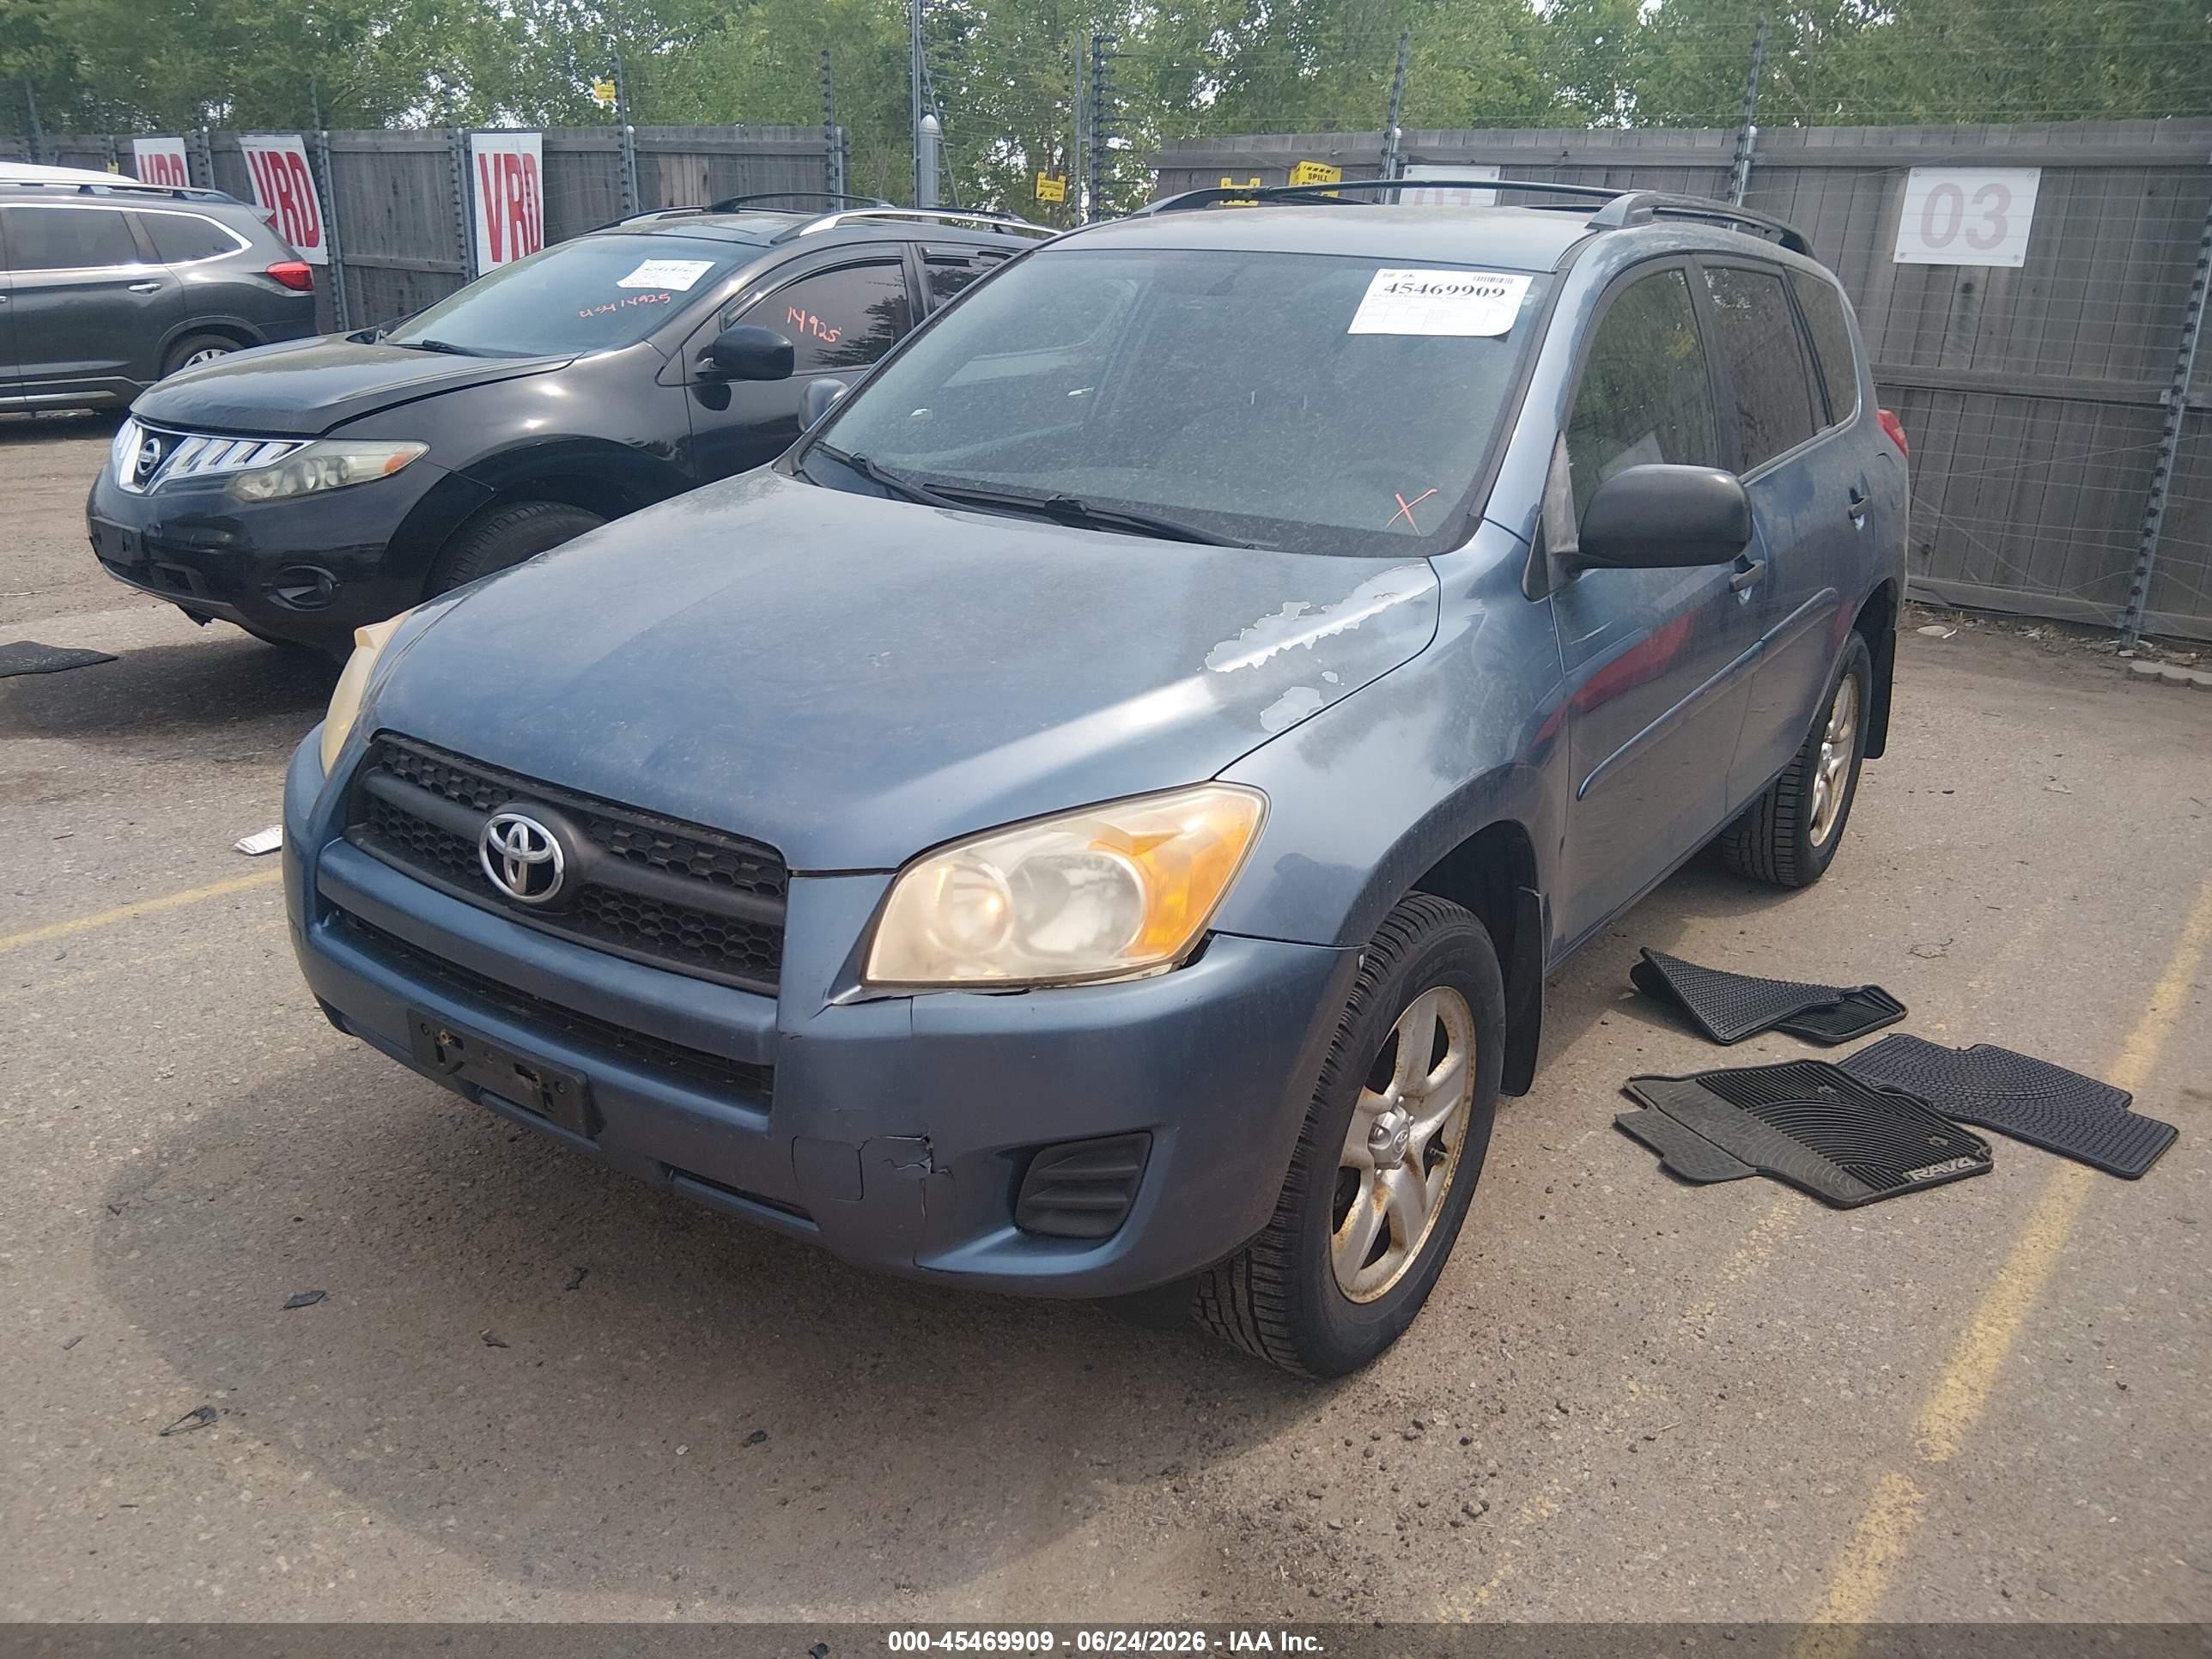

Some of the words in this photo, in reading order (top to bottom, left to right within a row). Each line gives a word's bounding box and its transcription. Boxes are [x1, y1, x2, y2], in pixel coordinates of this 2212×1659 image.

[1307, 173, 1328, 182] SPILL
[246, 151, 319, 247] VRD
[478, 153, 541, 262] VRD
[1921, 183, 2011, 250] 03
[1383, 282, 1506, 298] 45469909
[787, 306, 841, 342] 14925
[1903, 1156, 1976, 1181] RAV4
